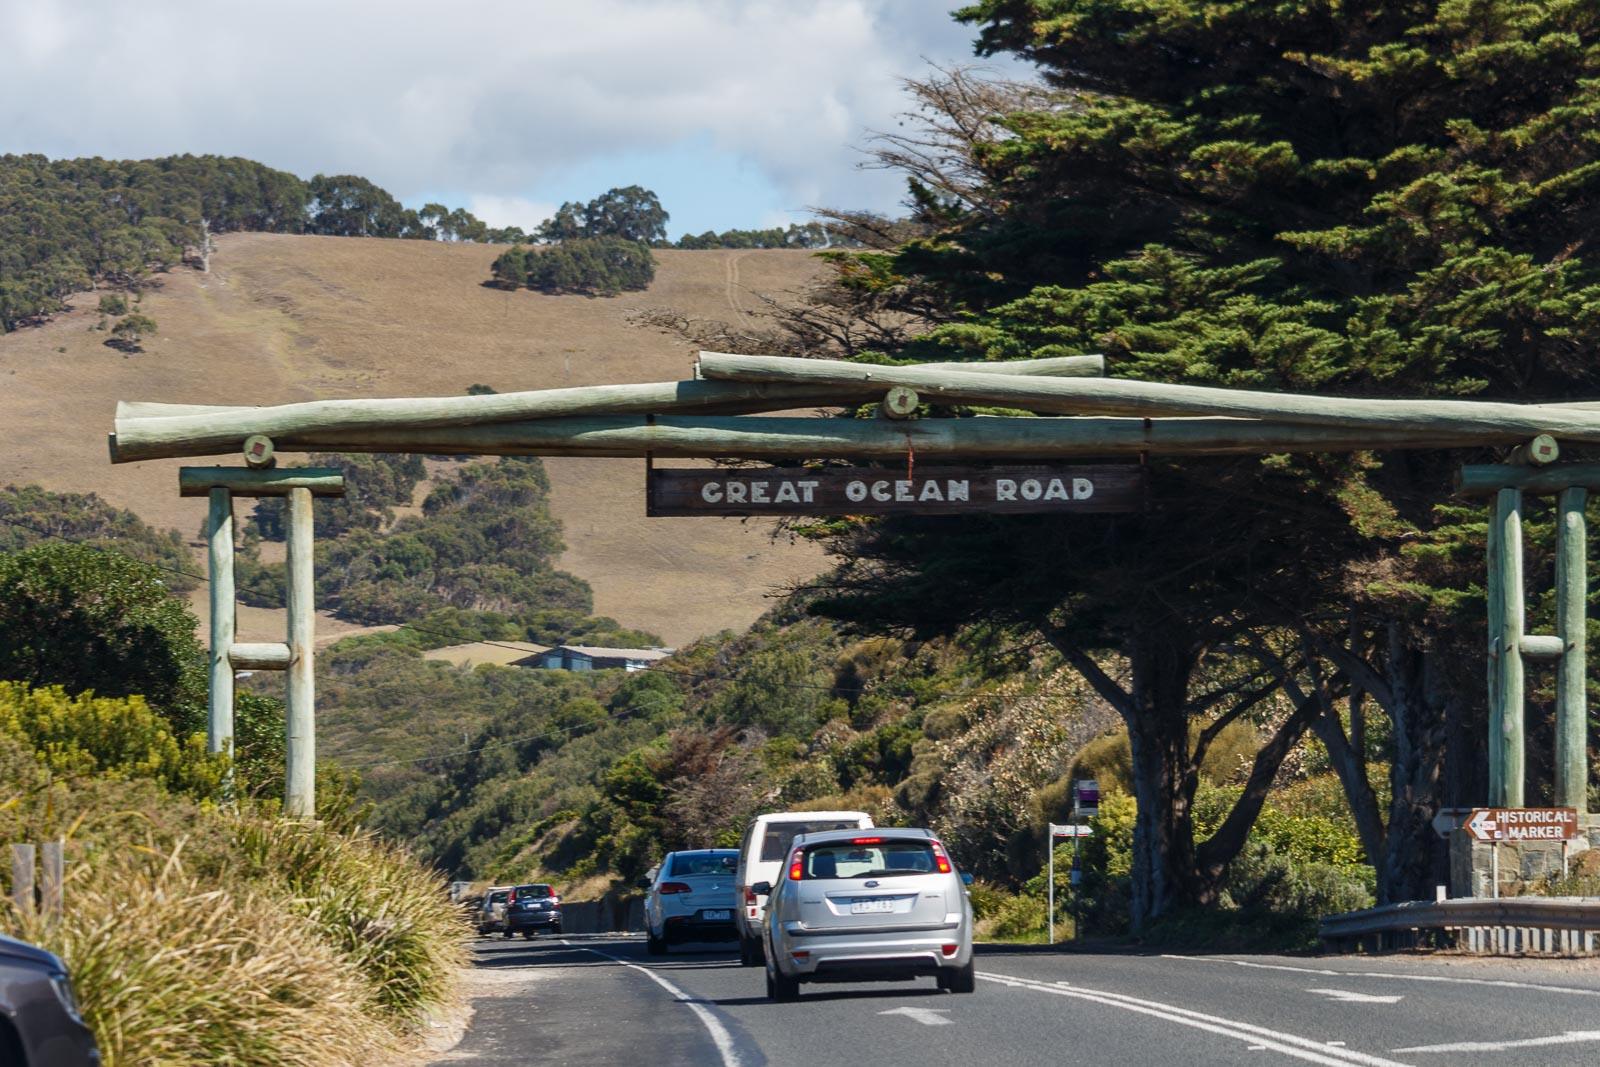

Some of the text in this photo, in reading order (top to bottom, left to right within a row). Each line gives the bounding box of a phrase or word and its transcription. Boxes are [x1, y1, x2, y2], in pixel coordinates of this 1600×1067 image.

[701, 478, 1094, 503] GREAT OCEAN ROAD
[1496, 811, 1572, 823] HISTORICAL
[1509, 826, 1563, 838] MARKER
